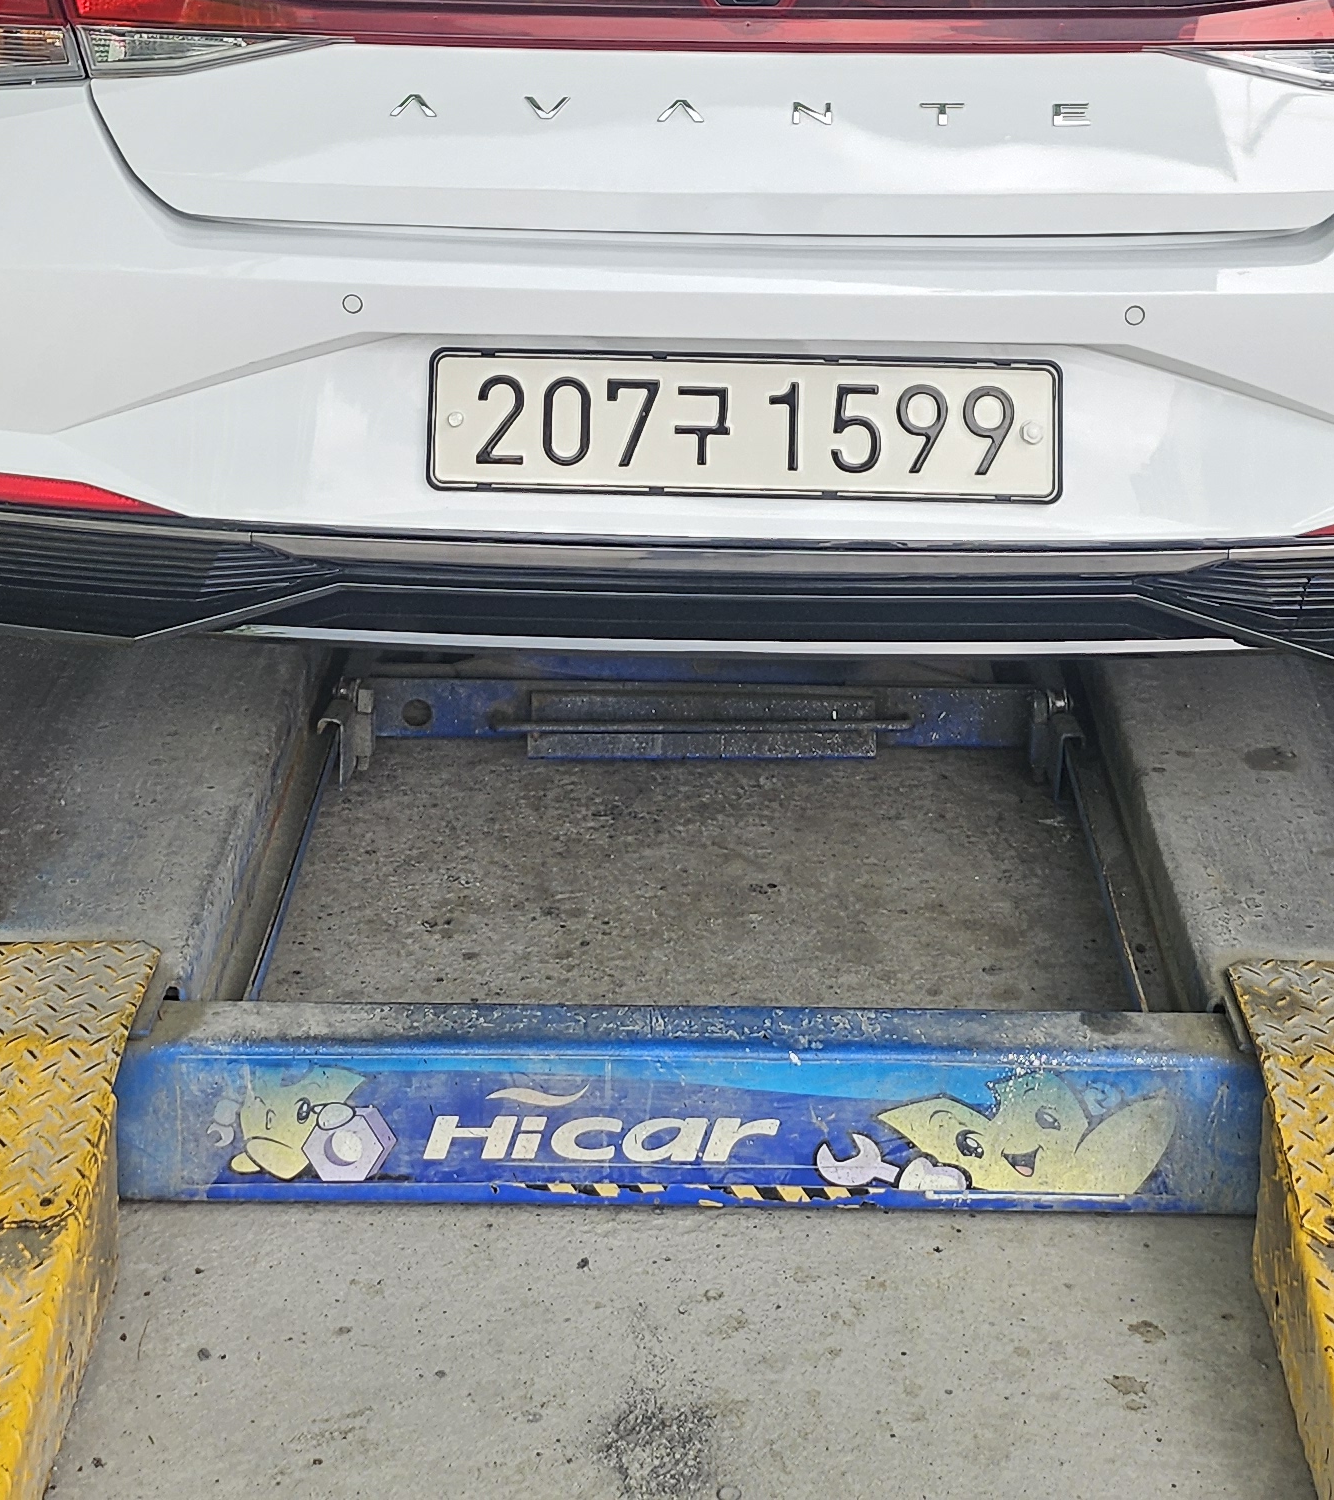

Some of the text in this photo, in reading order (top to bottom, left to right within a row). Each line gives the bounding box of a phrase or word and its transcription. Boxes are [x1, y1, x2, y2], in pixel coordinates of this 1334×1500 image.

[389, 93, 1091, 127] AVANTE
[475, 375, 1016, 476] 207구 1599
[423, 1115, 780, 1162] Hicar
